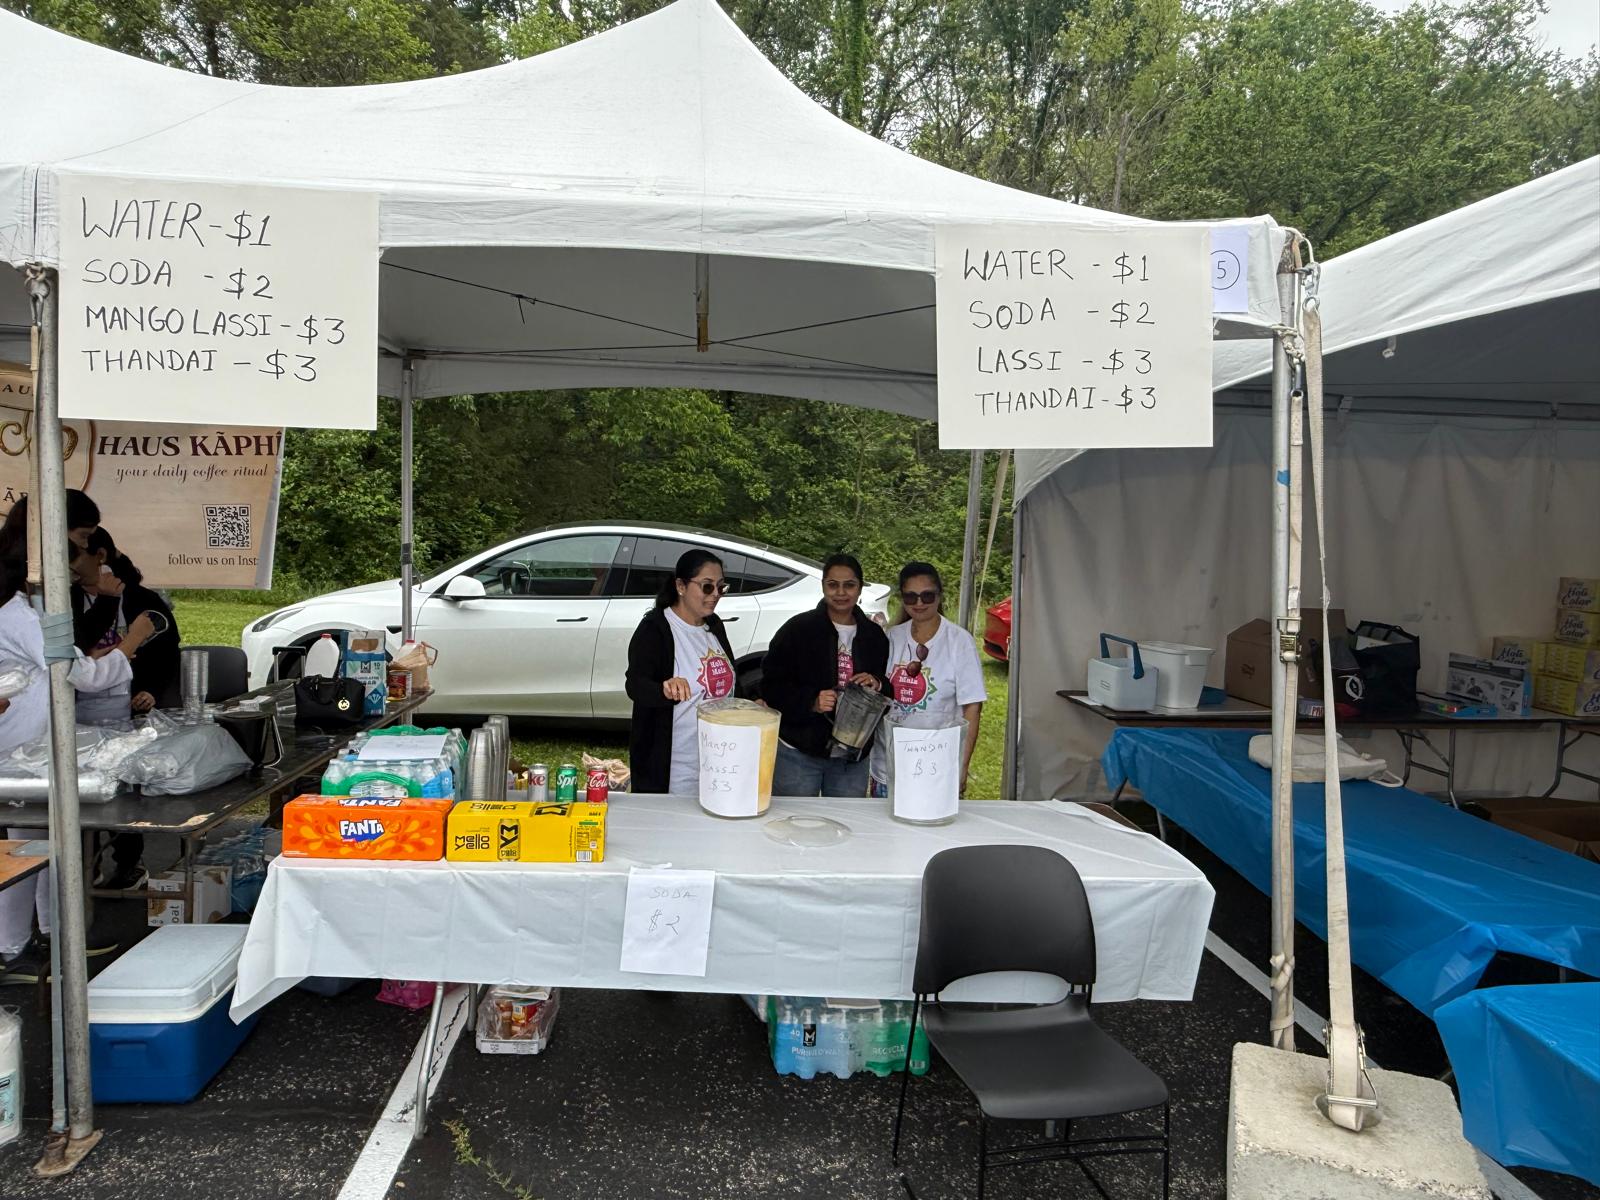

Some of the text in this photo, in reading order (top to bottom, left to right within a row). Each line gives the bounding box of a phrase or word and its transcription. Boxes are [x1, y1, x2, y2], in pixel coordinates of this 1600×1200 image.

[81, 196, 205, 248] WATER
[225, 210, 273, 248] $1
[81, 258, 173, 287] SODA
[222, 267, 274, 300] $2
[962, 248, 1075, 282] WATER
[1111, 251, 1150, 285] $1
[1216, 259, 1228, 280] 5
[85, 305, 185, 334] MANGO
[192, 309, 274, 338] LASSI
[296, 314, 346, 345] $3
[968, 297, 1057, 330] SODA
[1109, 299, 1156, 329] $2
[81, 348, 218, 373] THANDAI
[259, 348, 318, 383] $3
[976, 346, 1063, 375] LASSI
[1101, 348, 1153, 375] $3
[974, 386, 1097, 417] THANDAI
[1115, 384, 1157, 414] $3
[97, 435, 181, 456] HAUS
[116, 464, 268, 484] your daily coffee ritual
[168, 554, 203, 566] follow
[206, 556, 219, 566] us
[221, 557, 235, 566] on
[339, 819, 385, 836] FANTA
